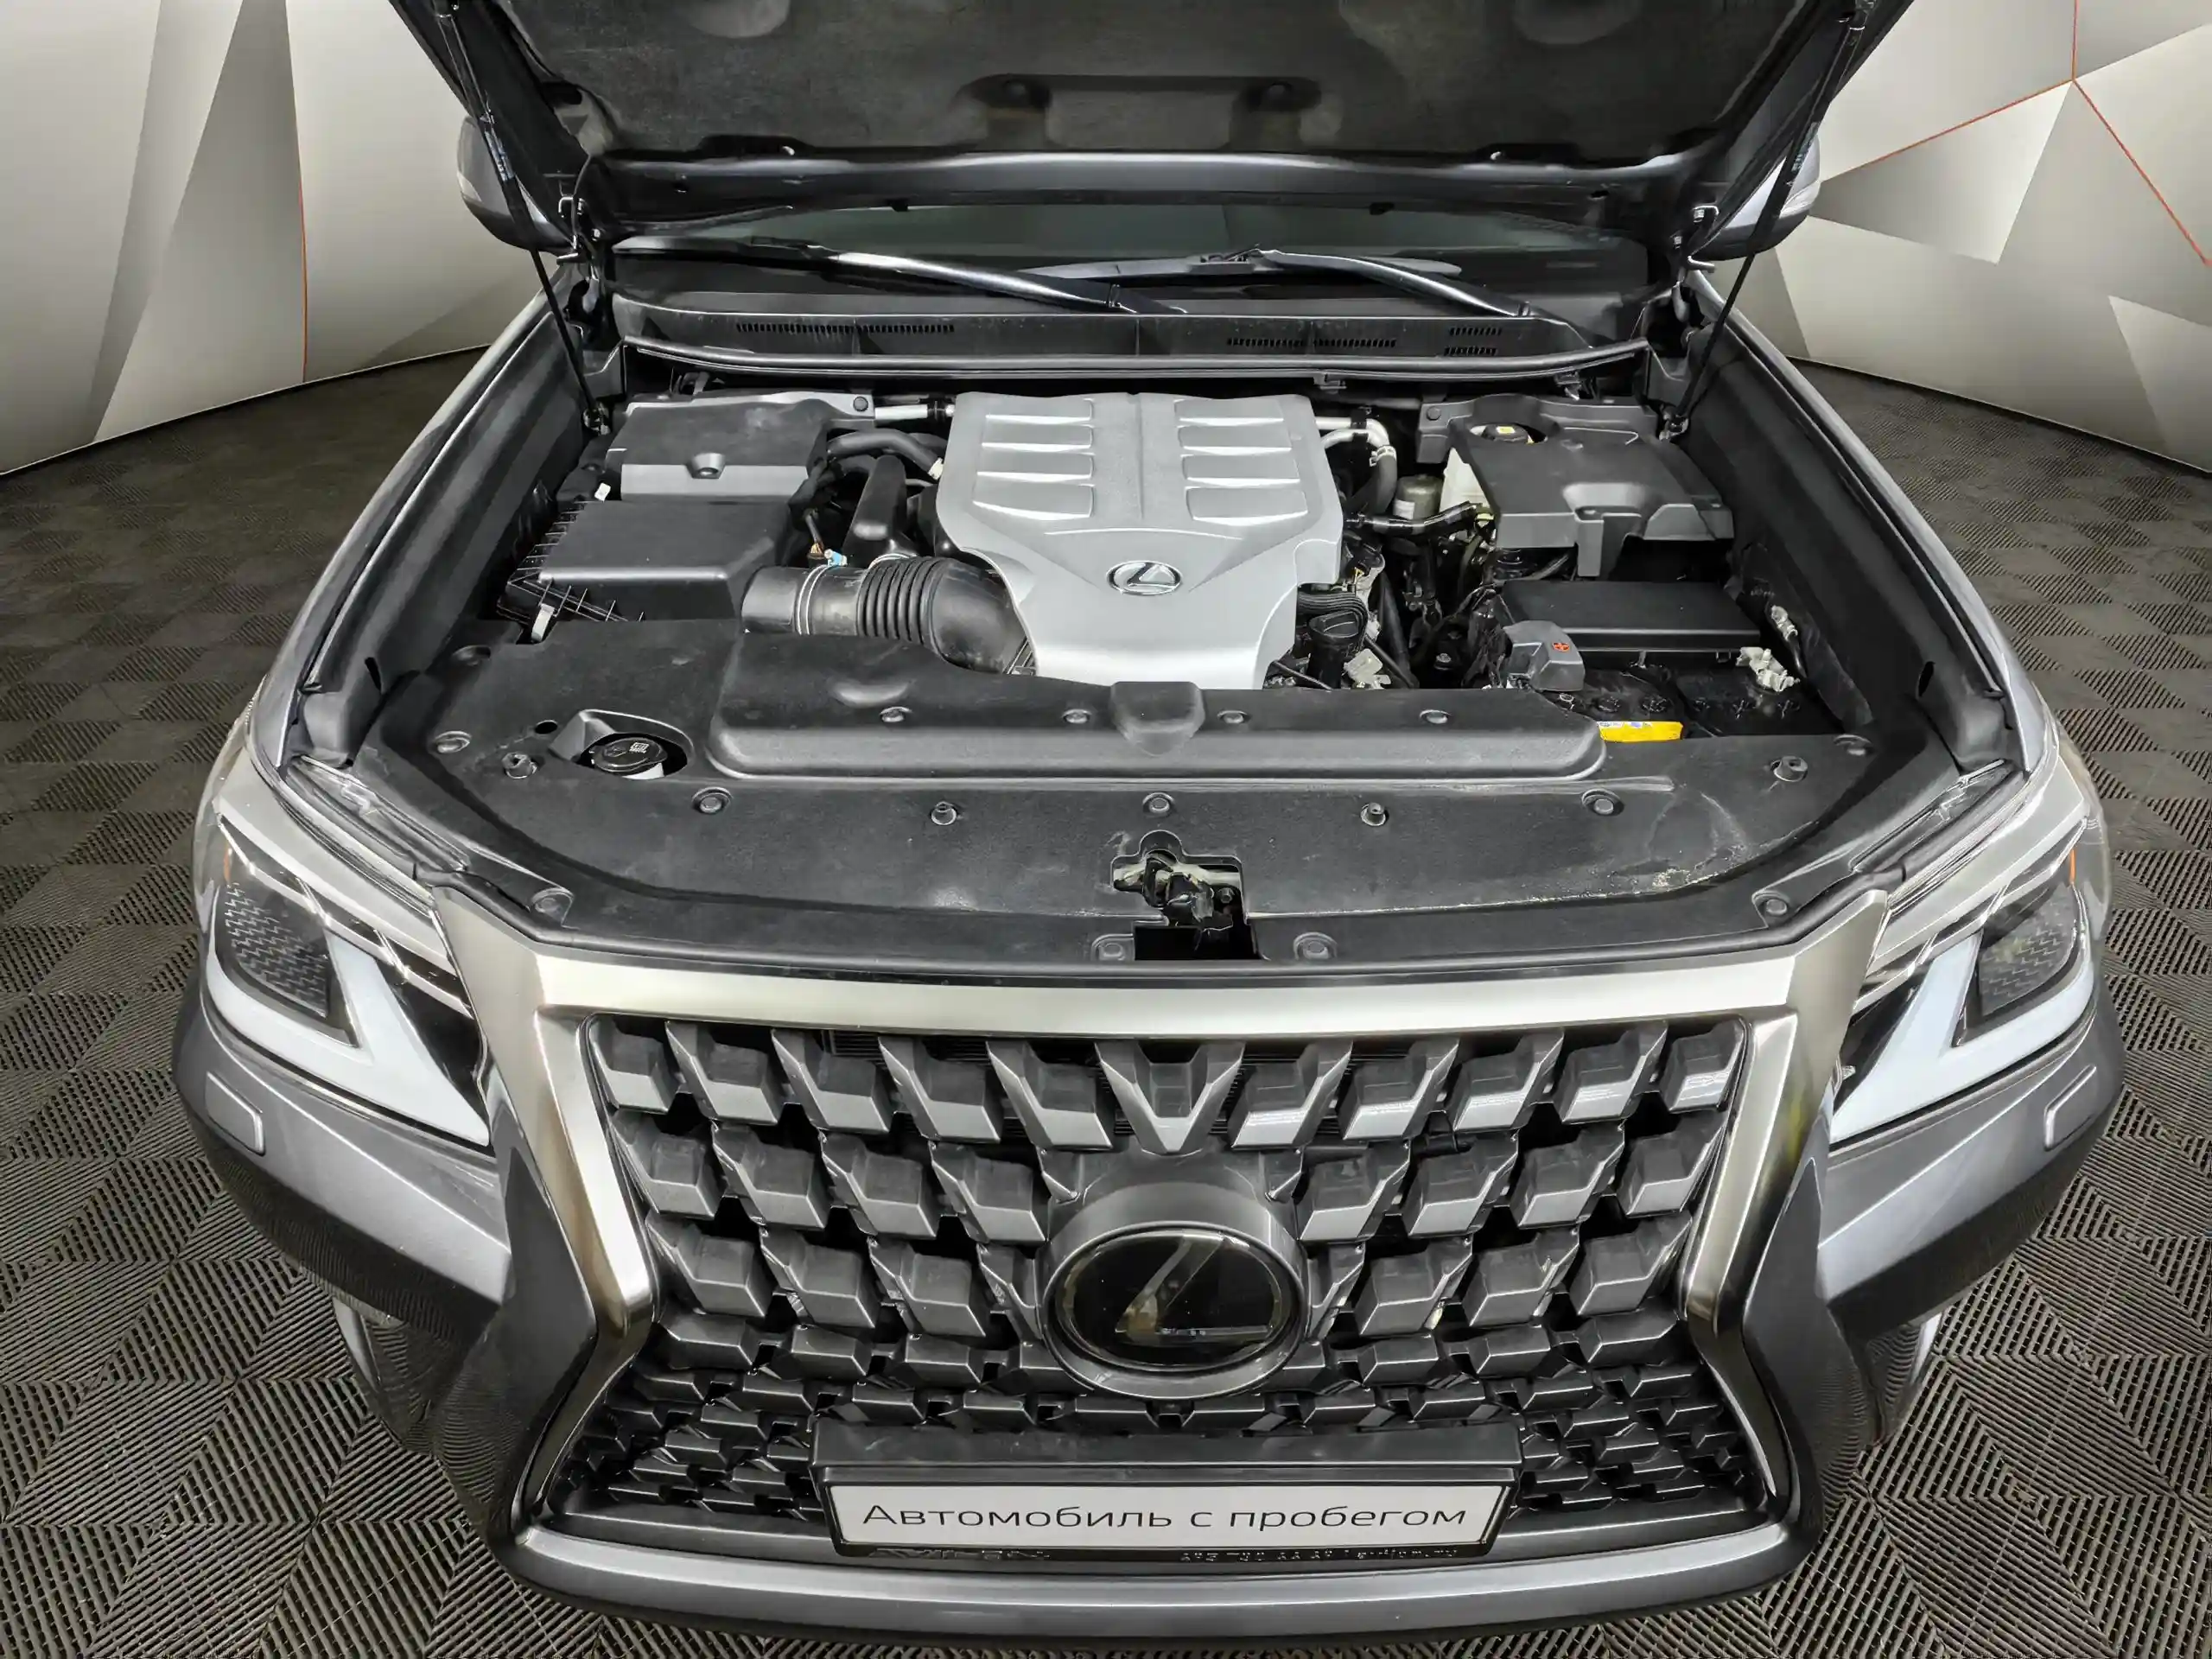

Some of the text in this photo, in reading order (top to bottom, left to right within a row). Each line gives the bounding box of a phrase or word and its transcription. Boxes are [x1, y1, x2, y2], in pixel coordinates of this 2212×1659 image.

[862, 1504, 1466, 1532] Автомобиль с пробегом
